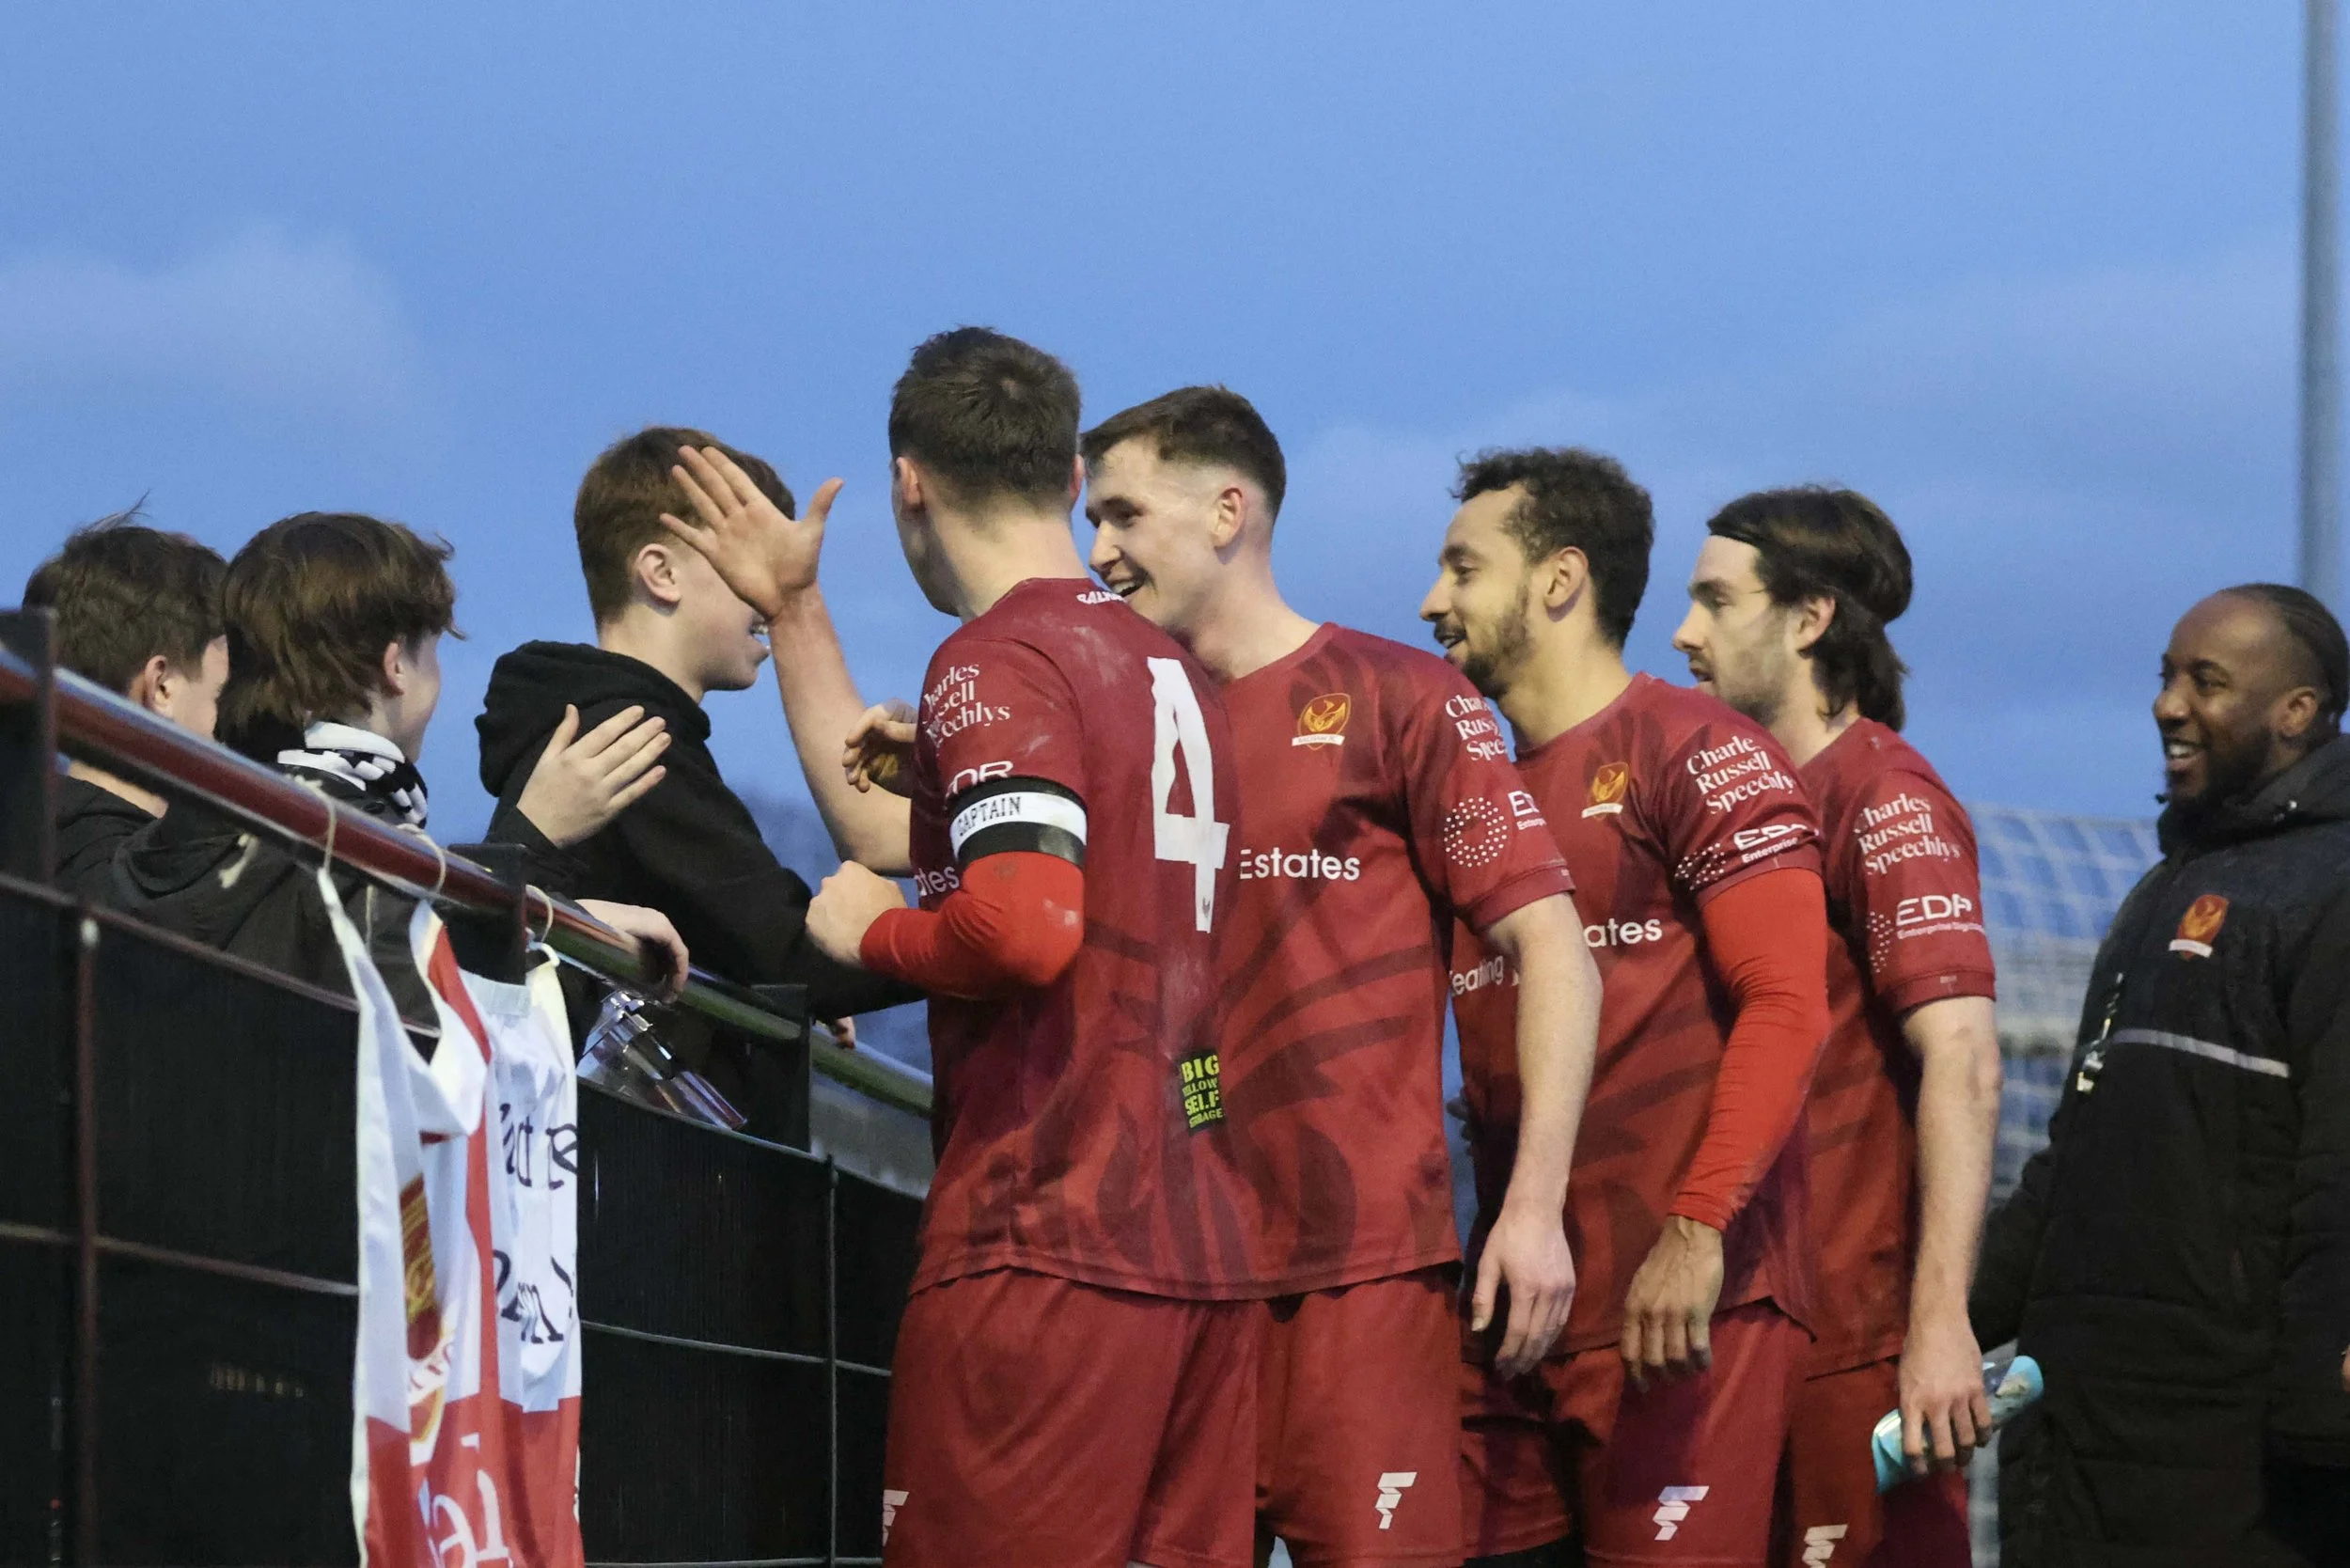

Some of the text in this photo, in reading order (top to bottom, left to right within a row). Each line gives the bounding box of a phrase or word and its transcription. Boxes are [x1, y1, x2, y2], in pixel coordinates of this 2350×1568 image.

[1686, 736, 1760, 776] Charle
[1696, 751, 1772, 796] Russell
[1147, 656, 1230, 933] 4
[956, 796, 1022, 837] CAPTAIN
[1857, 813, 1935, 855] Russell
[1239, 847, 1361, 882] Estates
[1741, 837, 1799, 865] Enterprise
[1181, 1055, 1220, 1084] BIG
[1184, 1090, 1220, 1116] SELF
